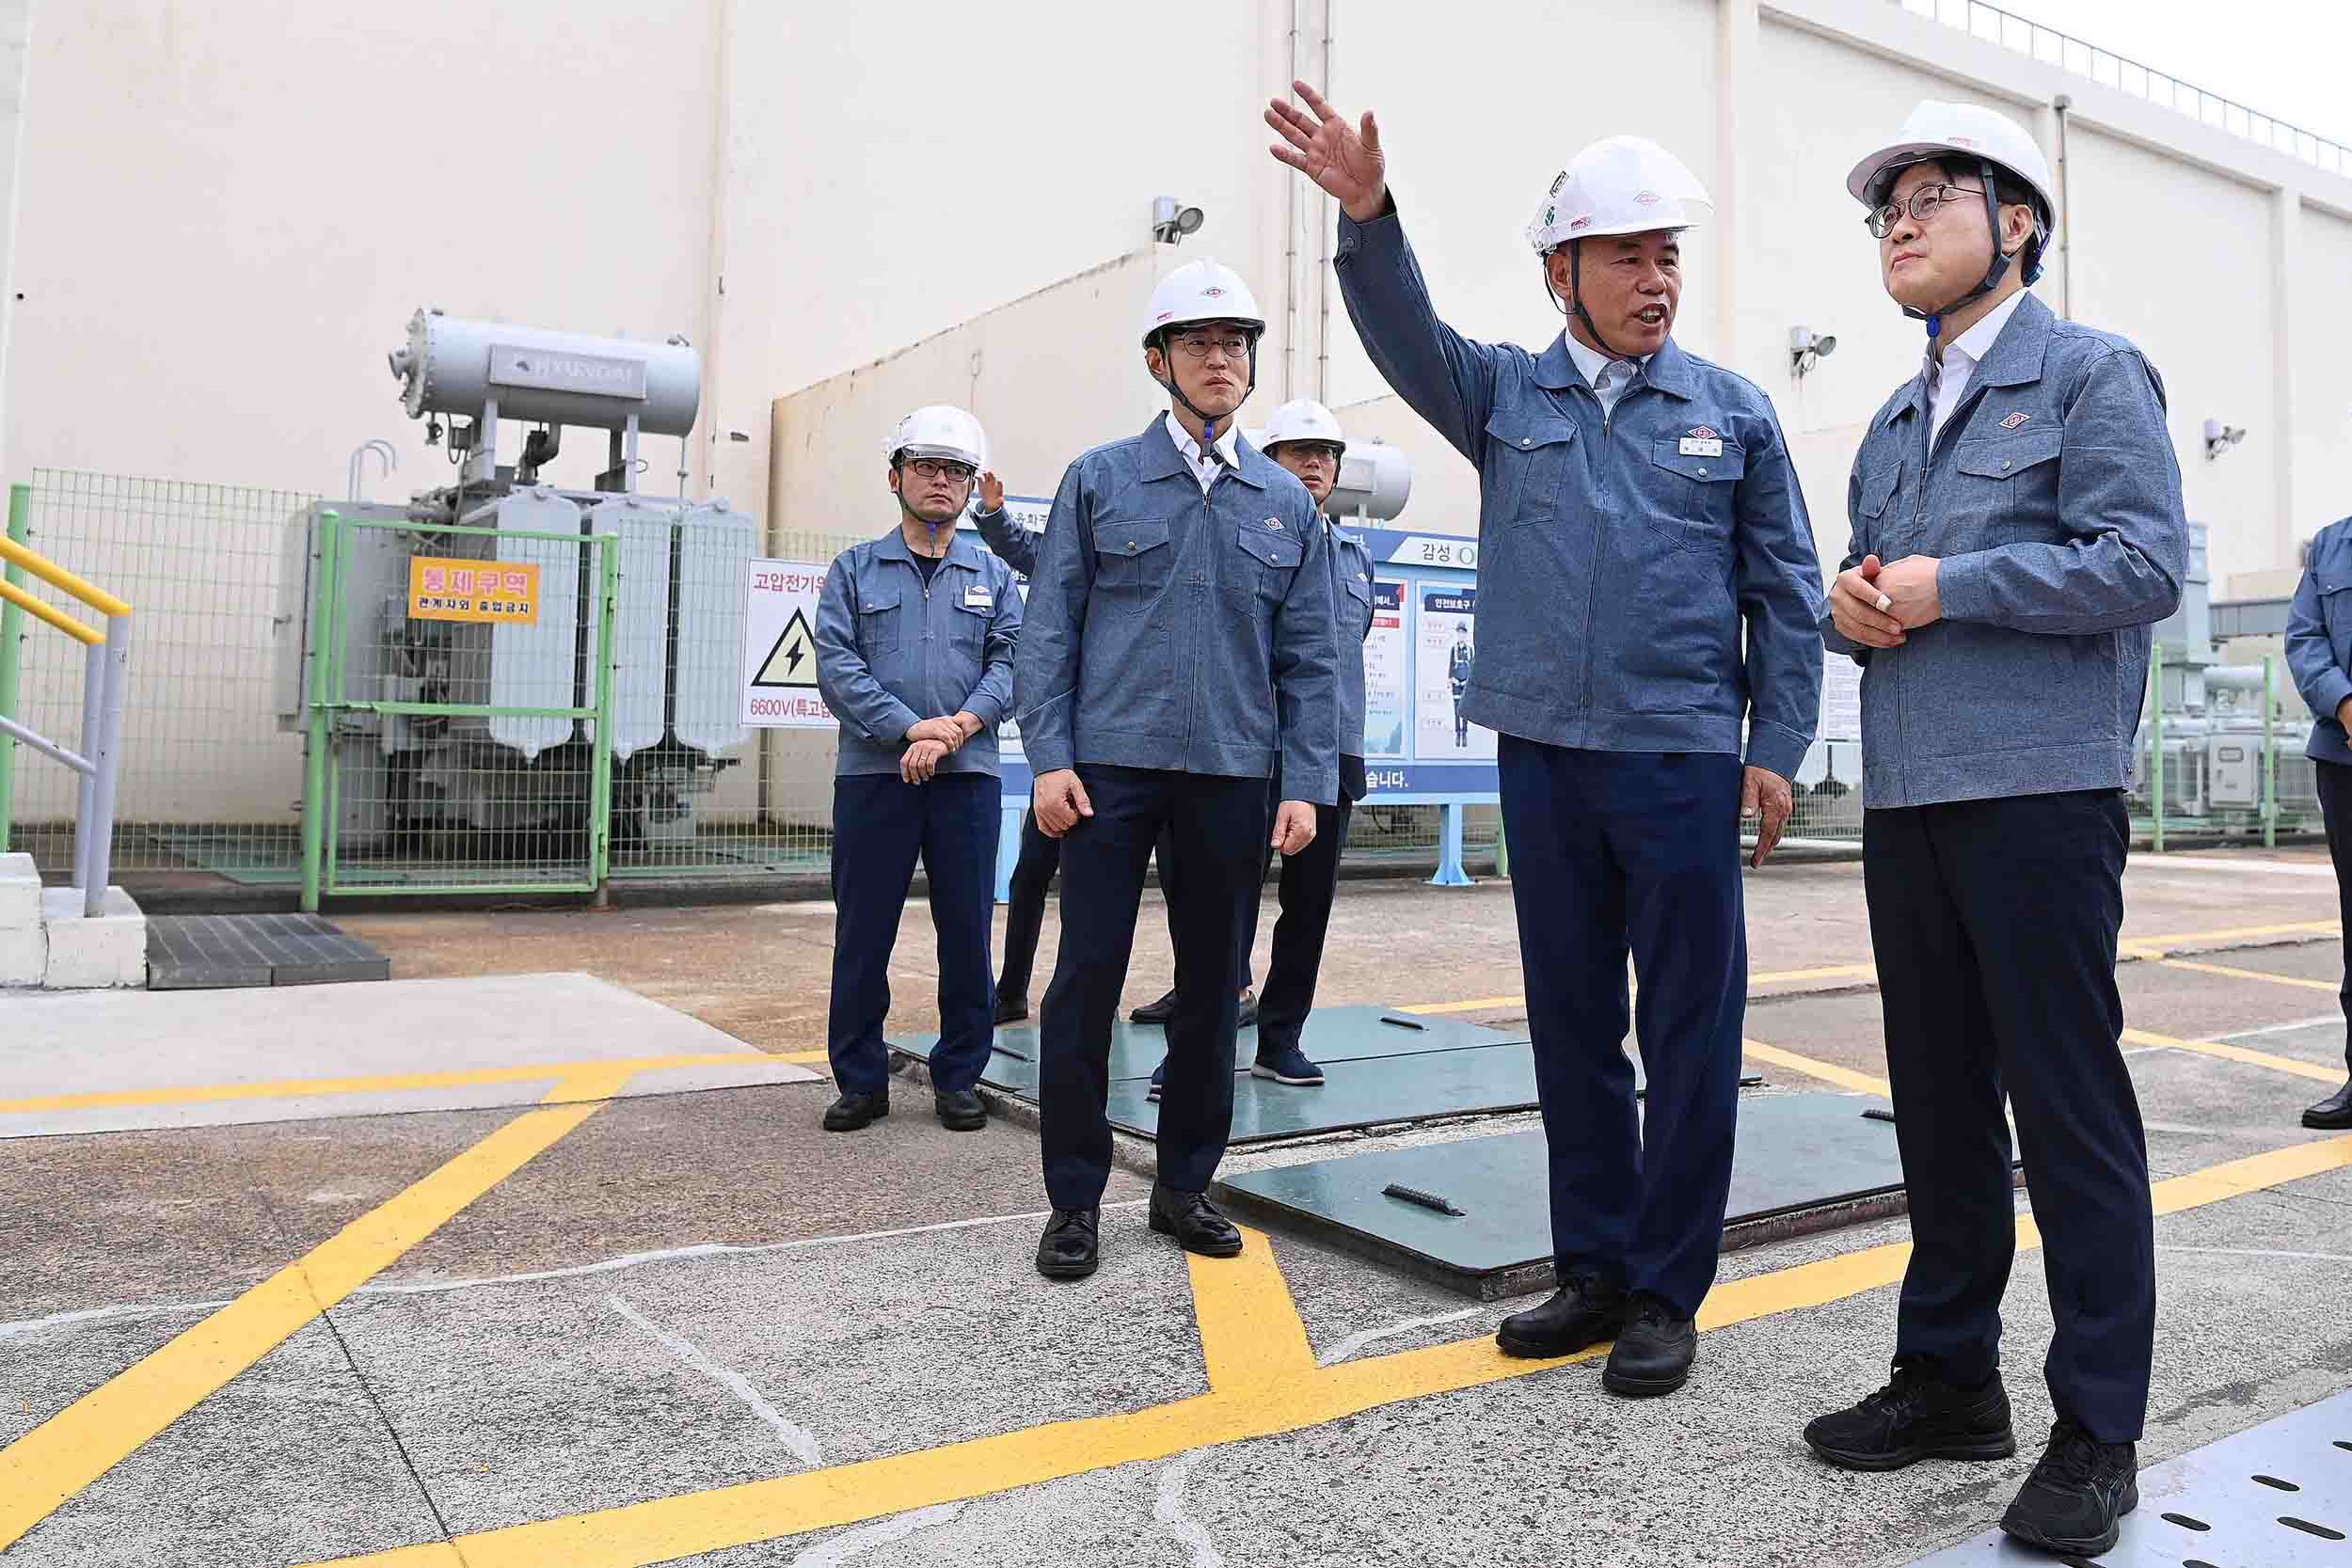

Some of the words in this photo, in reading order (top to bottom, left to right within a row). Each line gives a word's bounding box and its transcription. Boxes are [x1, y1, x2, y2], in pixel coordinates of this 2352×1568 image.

[1422, 543, 1451, 562] 감성
[422, 567, 528, 597] 통제구역
[419, 596, 469, 610] 관계자외
